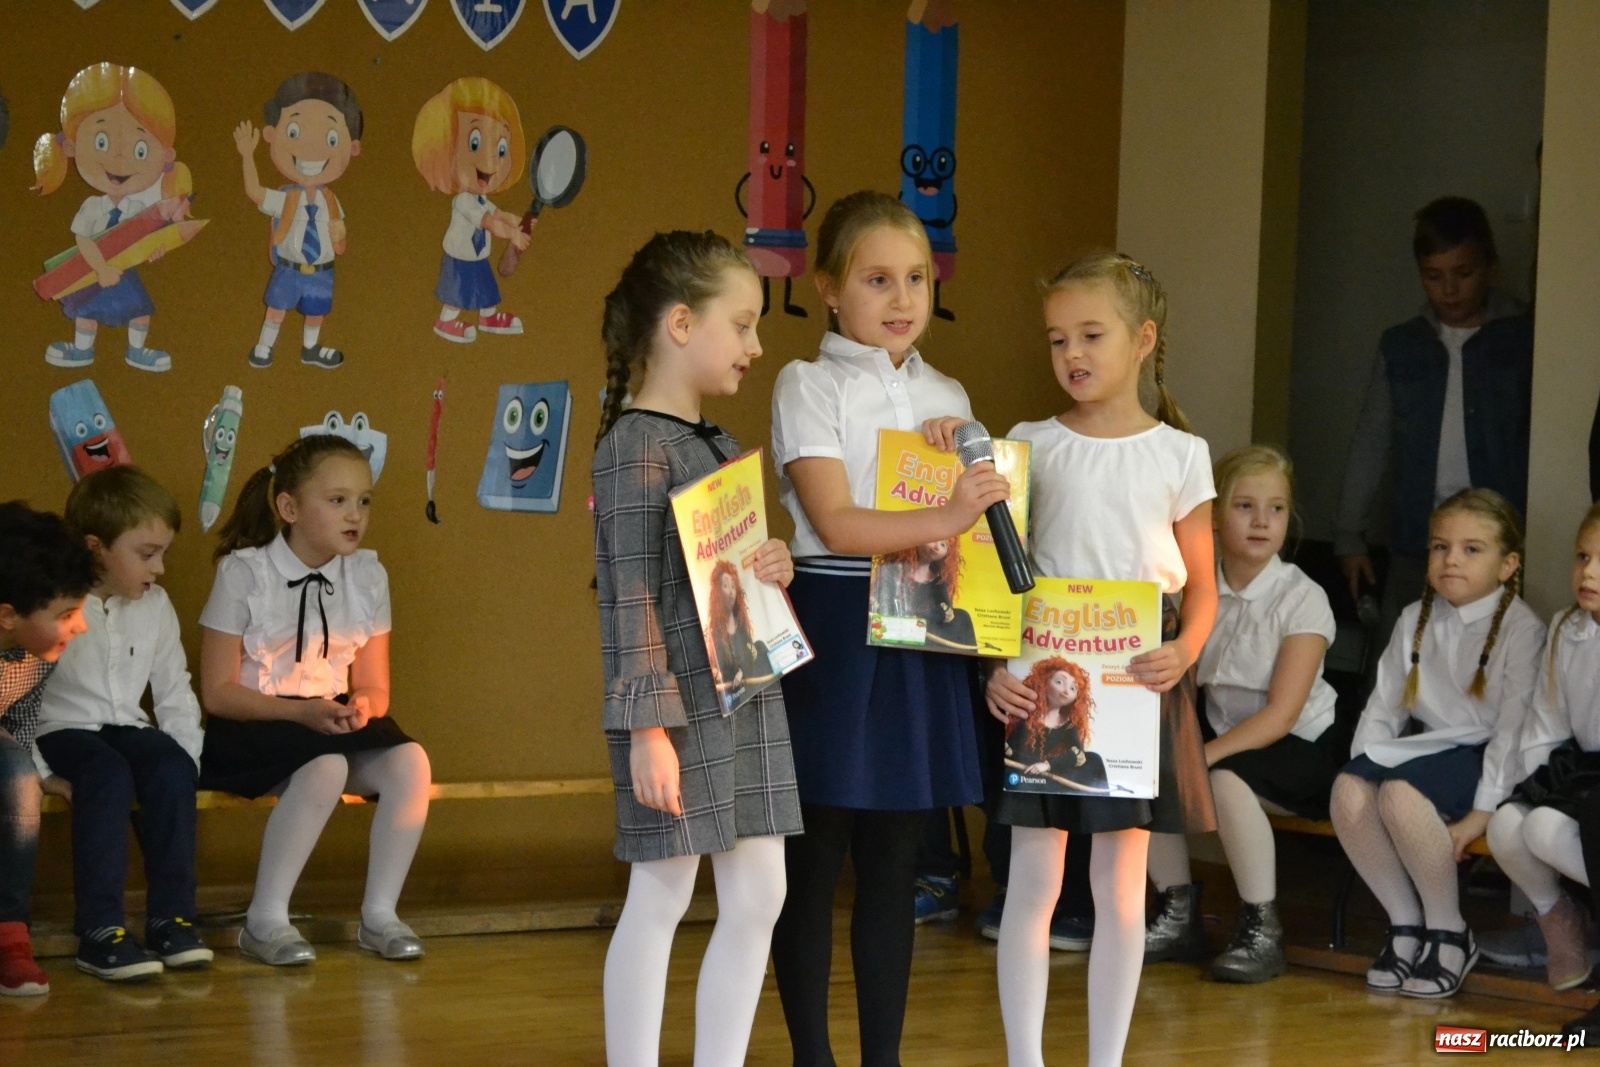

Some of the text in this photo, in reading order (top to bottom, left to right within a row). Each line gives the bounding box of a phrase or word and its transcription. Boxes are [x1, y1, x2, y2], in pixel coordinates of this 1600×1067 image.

[896, 450, 962, 493] Engl
[708, 478, 722, 493] NEW
[692, 484, 752, 538] English
[697, 511, 757, 560] Adventure
[1068, 584, 1094, 594] NEW
[1025, 597, 1137, 635] English
[1022, 626, 1141, 653] Adventure
[1106, 675, 1134, 683] POZIOM
[1020, 776, 1047, 785] Pearson
